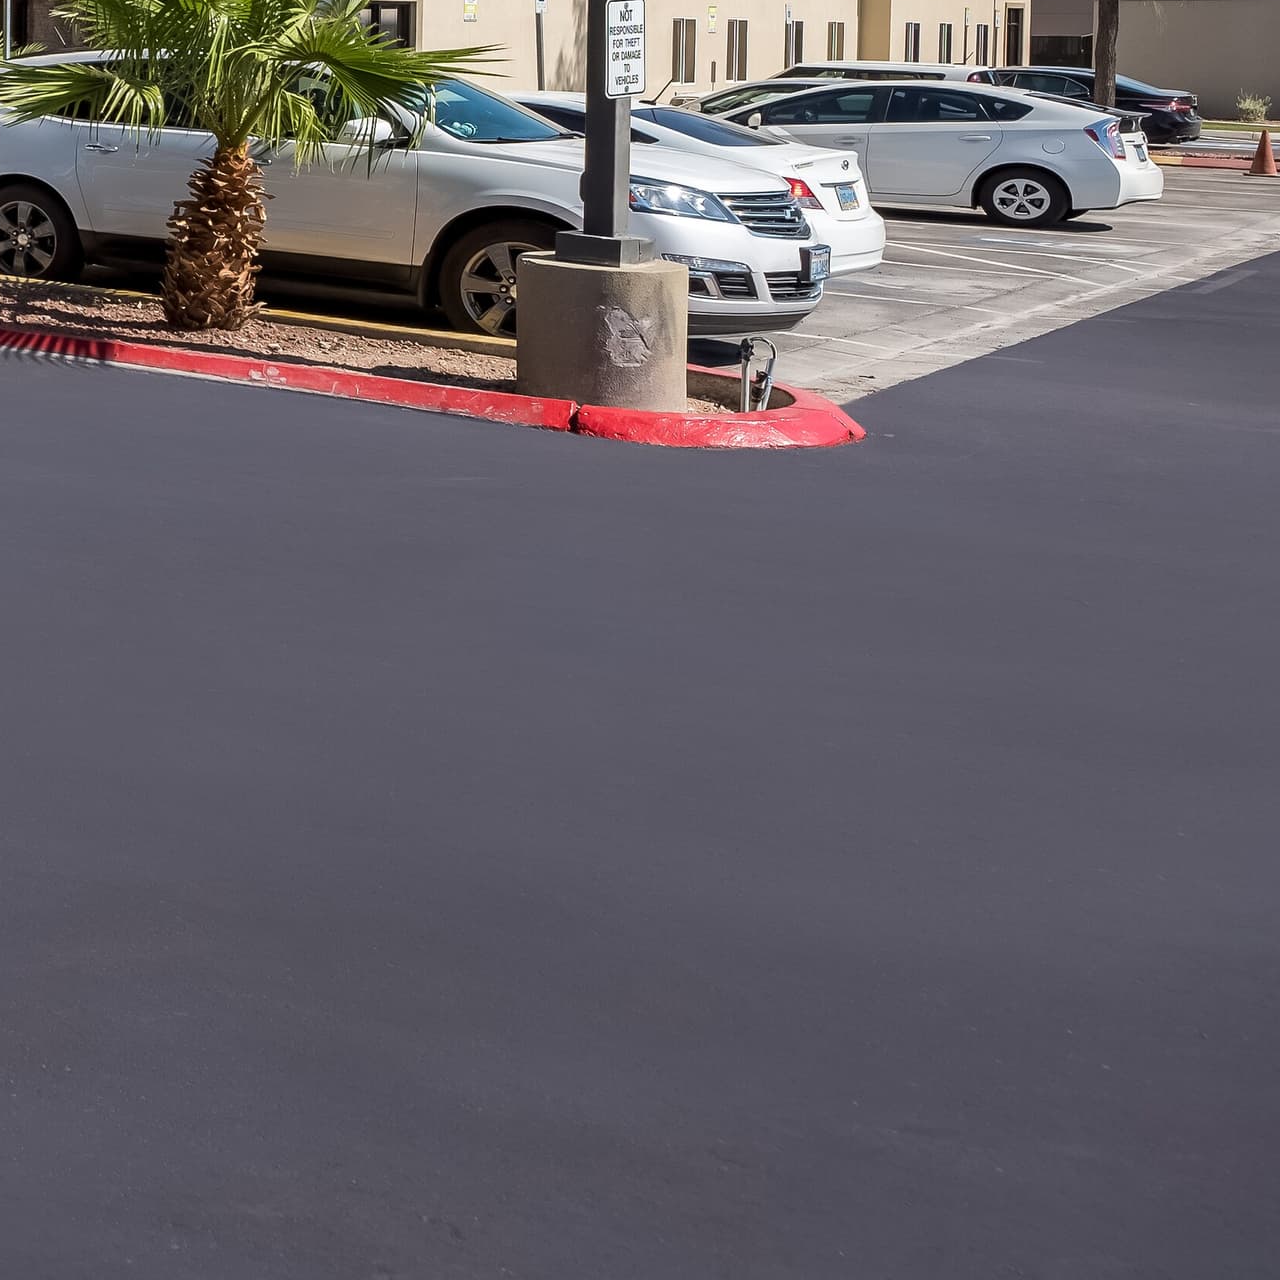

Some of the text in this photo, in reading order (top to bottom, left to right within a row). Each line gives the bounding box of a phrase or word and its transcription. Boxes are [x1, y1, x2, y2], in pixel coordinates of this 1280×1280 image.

[619, 9, 633, 22] NOT
[609, 24, 643, 36] RESPONSIBLE
[612, 37, 640, 49] FOR THEFT
[612, 50, 641, 61] OR DAMAGE
[624, 63, 631, 73] TO
[615, 74, 639, 85] VEHICLES
